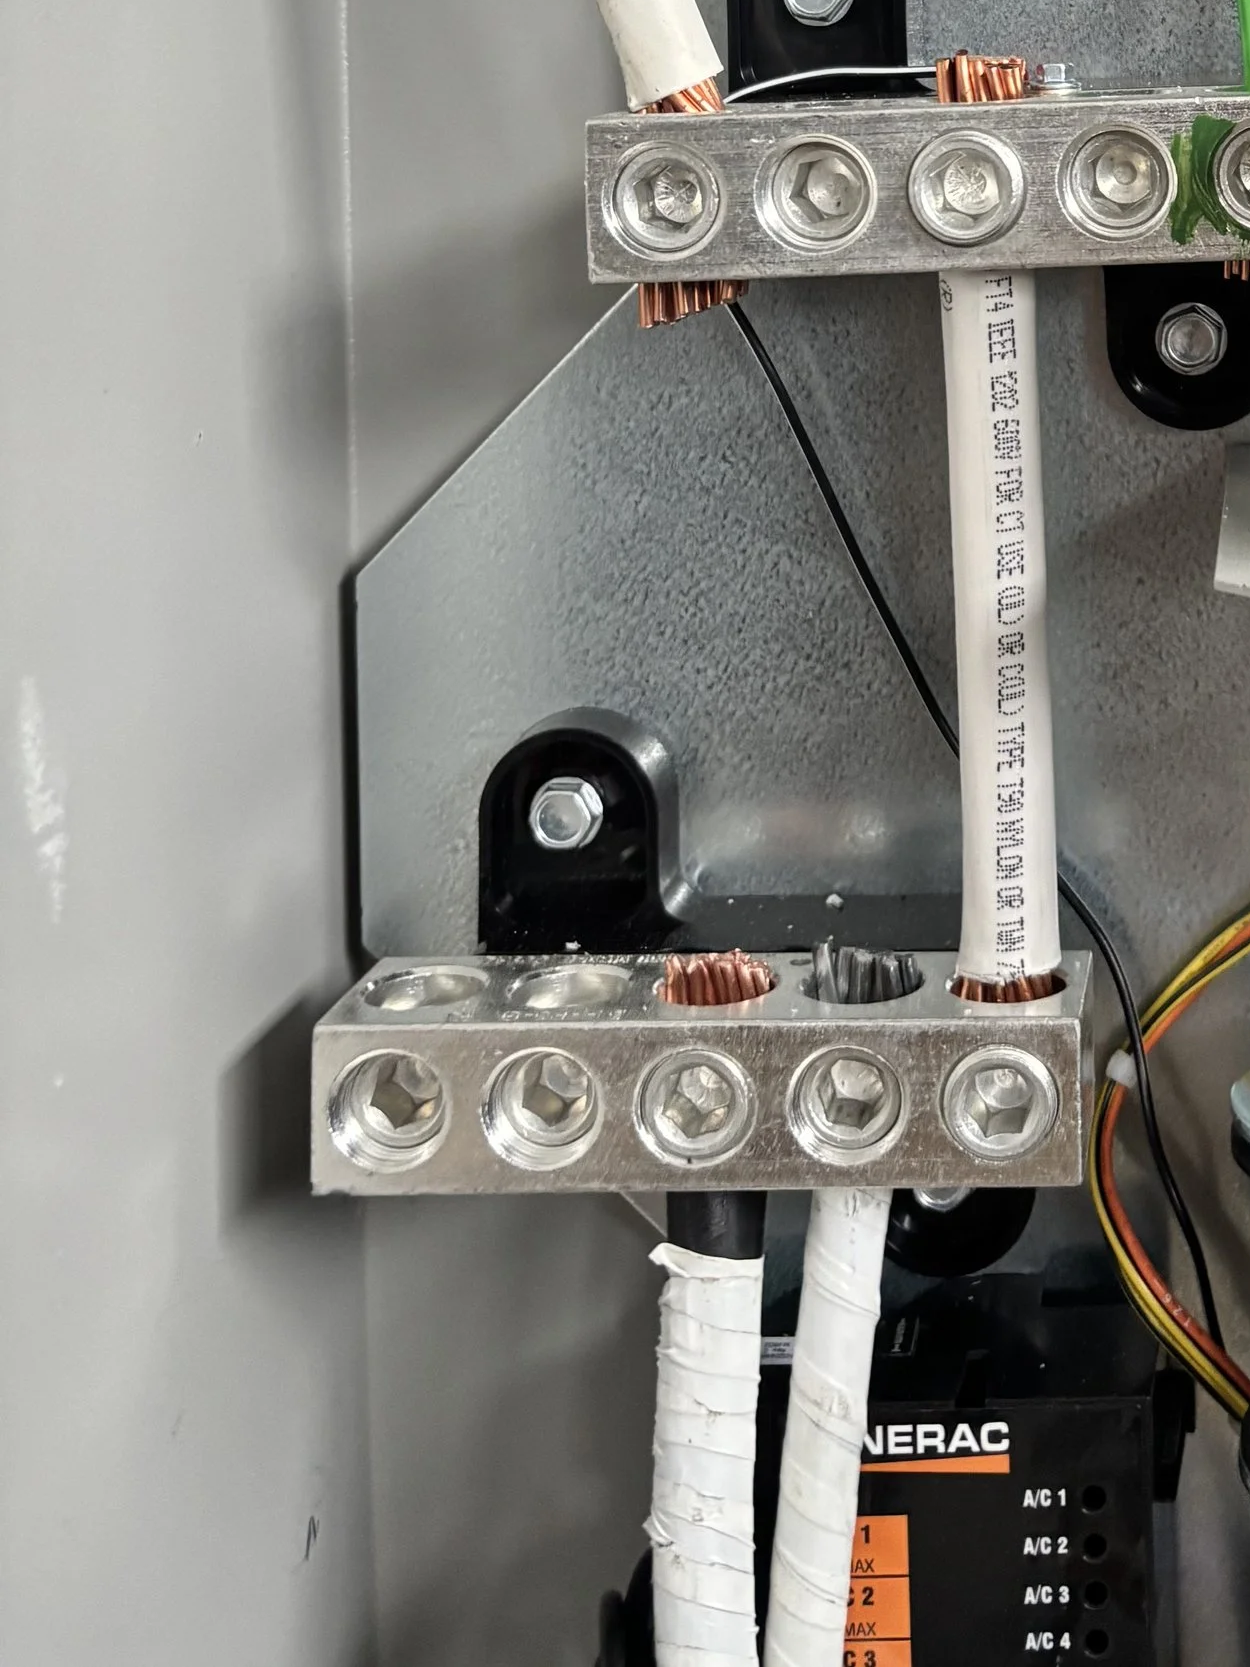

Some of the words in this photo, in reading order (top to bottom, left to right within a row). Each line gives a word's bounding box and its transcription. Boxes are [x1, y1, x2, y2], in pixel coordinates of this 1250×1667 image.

[985, 275, 1013, 313] FT4
[987, 318, 1017, 363] IEEE
[991, 370, 1019, 412] 1202
[995, 466, 1024, 506] FOR
[996, 510, 1024, 533] CT
[997, 539, 1025, 580] USE
[998, 586, 1025, 625] (UL)
[997, 631, 1025, 659] OR
[997, 721, 1025, 773] TYPE
[997, 777, 1025, 814] T90
[996, 818, 1025, 879] NYLON
[996, 885, 1025, 911] OR
[1022, 1488, 1052, 1508] A/C
[1057, 1488, 1067, 1506] 1
[1023, 1537, 1052, 1555] A/C
[1056, 1536, 1069, 1554] 2
[861, 1586, 875, 1606] 2
[1024, 1586, 1053, 1605] A/C
[1058, 1586, 1070, 1603] 3
[1025, 1633, 1054, 1651] A/C
[1059, 1632, 1071, 1650] 4
[864, 1650, 876, 1667] 3
